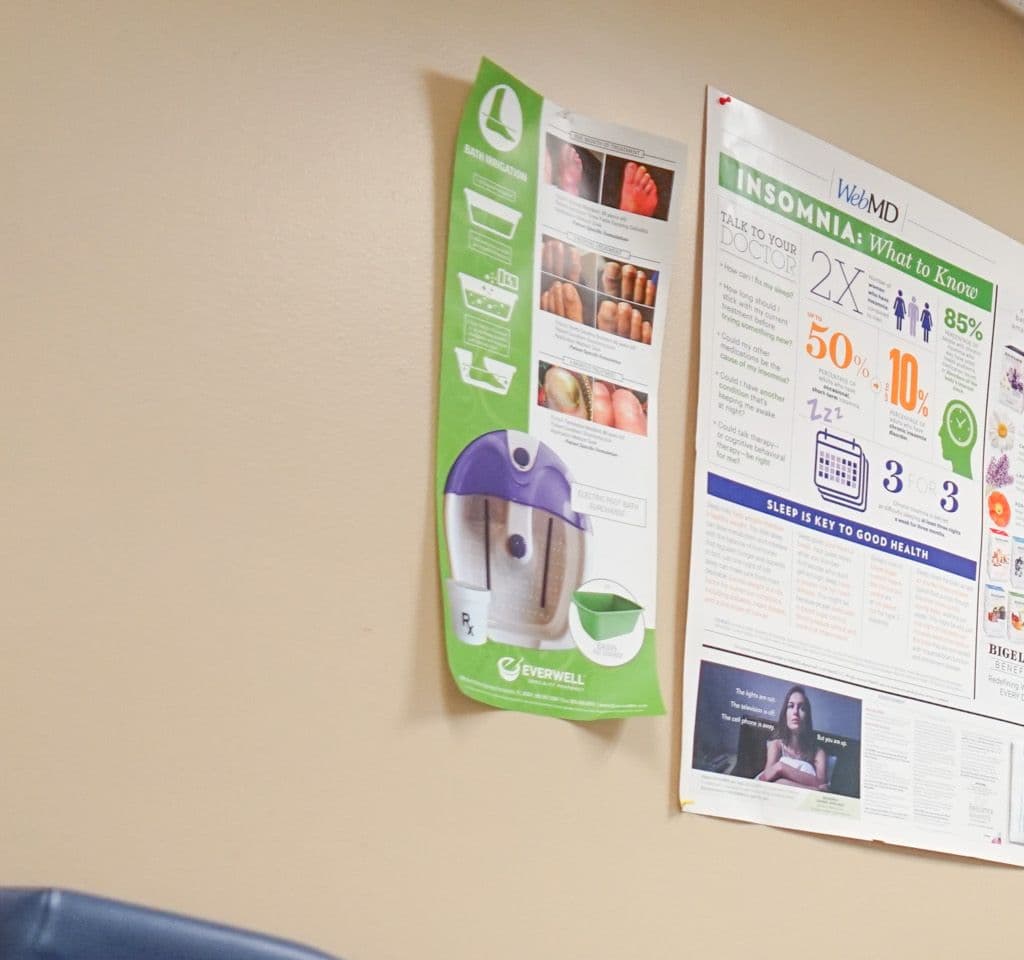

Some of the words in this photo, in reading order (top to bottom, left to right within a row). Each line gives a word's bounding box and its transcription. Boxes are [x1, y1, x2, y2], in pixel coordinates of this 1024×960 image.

[836, 178, 899, 224] WebMD
[720, 225, 798, 274] DOCTOR
[721, 211, 748, 233] TALK
[751, 225, 766, 240] TO
[768, 233, 797, 255] YOUR
[736, 168, 864, 245] INSOMNIA:
[870, 233, 913, 269] What
[916, 258, 930, 278] to
[934, 265, 978, 299] Know
[810, 250, 865, 315] 2X
[944, 307, 983, 341] 85%
[806, 321, 870, 378] 50%
[889, 348, 928, 417] 10%
[883, 460, 904, 494] 3
[940, 480, 959, 513] 3
[766, 499, 798, 518] SLEEP
[801, 511, 812, 523] IS
[814, 516, 836, 530] KEY
[838, 522, 853, 536] TO
[856, 529, 888, 547] GOOD
[890, 540, 929, 560] HEALTH
[522, 664, 584, 686] EVERWELL
[736, 688, 745, 696] The
[731, 700, 740, 708] The
[732, 716, 740, 724] cell
[741, 717, 757, 727] phone
